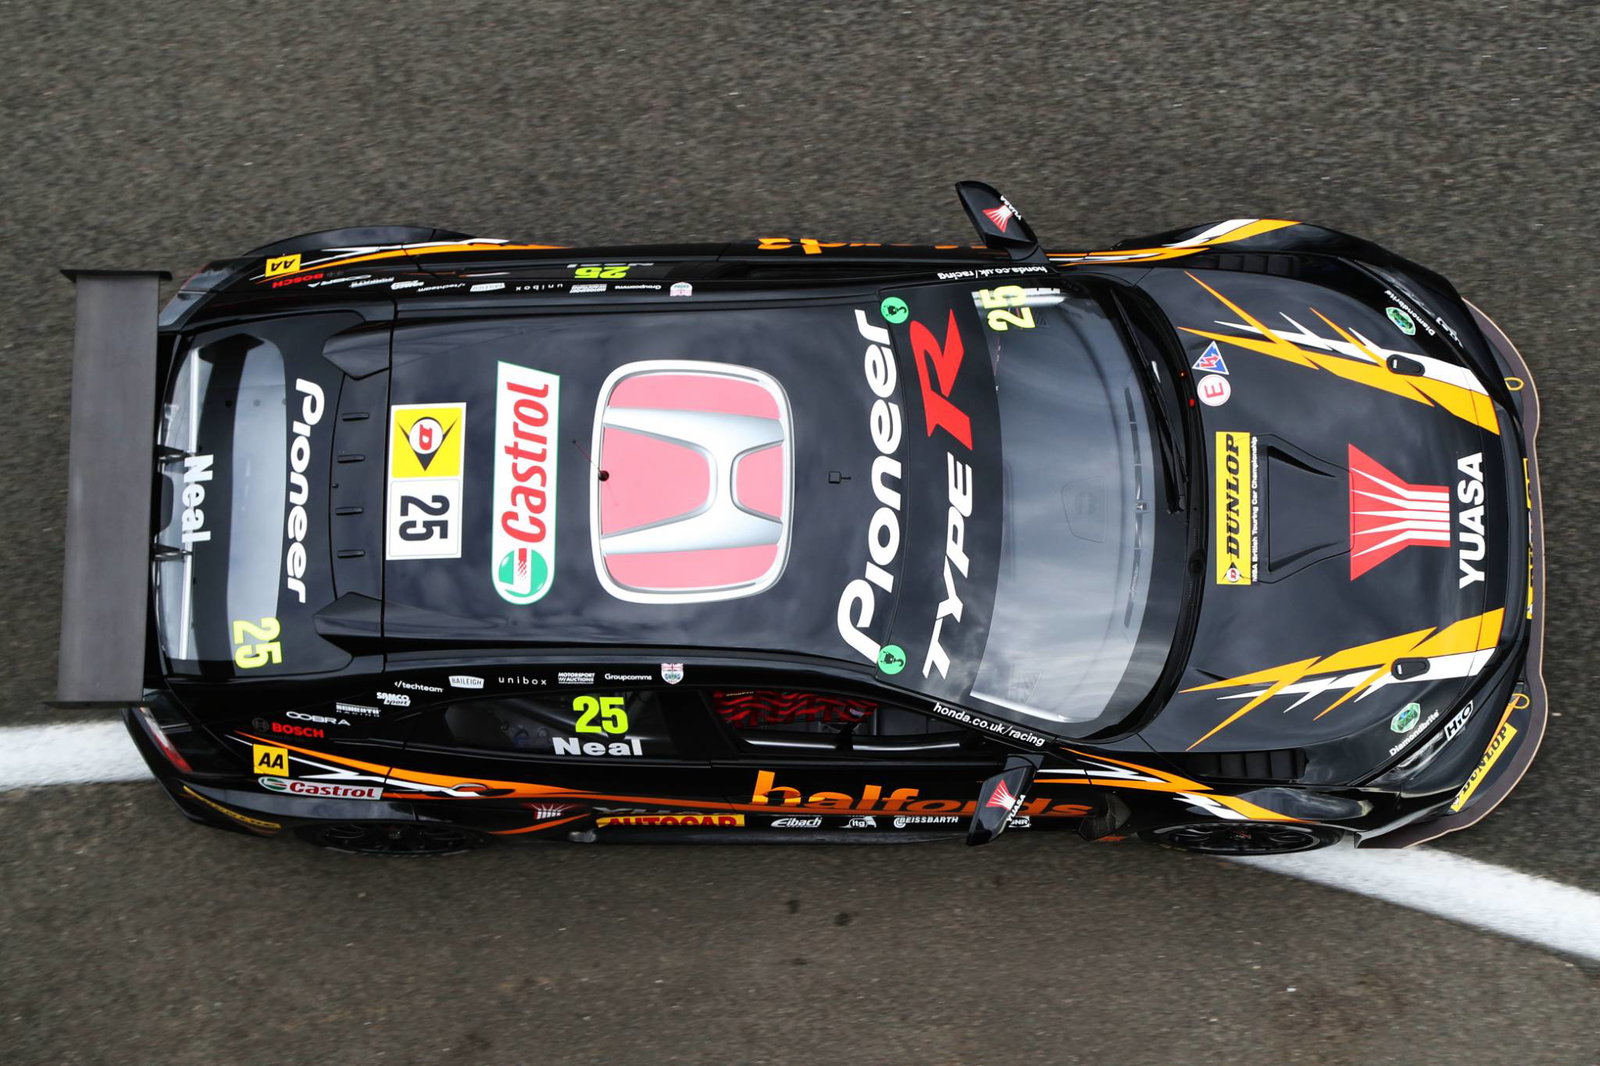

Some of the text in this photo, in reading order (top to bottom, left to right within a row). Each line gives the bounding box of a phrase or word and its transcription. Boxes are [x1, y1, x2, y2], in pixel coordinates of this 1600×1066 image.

[271, 258, 295, 272] AA
[574, 266, 630, 279] 25
[979, 285, 1036, 331] 25
[1204, 382, 1225, 399] E
[500, 381, 550, 543] Castrol
[181, 454, 214, 543] Neal
[286, 378, 325, 604] Pioneer
[836, 309, 902, 664] Pioneer
[909, 308, 973, 680] TYPE R
[1226, 433, 1240, 559] DUNLOP
[399, 494, 451, 542] 25
[1251, 506, 1259, 535] Touring
[1457, 452, 1486, 589] YUASA
[232, 617, 282, 669] 25
[499, 676, 547, 686] unibox
[605, 673, 653, 681] Groupcomms
[271, 722, 325, 738] BOSCH
[286, 711, 351, 726] COBRA
[572, 695, 629, 734] 25
[933, 702, 1045, 747] honda.co.uk/racing
[552, 737, 643, 757] Neal
[1389, 709, 1439, 757] Diamondbrite
[258, 752, 284, 769] AA
[290, 782, 376, 799] Castrol
[771, 816, 822, 828] Eibach
[1007, 794, 1026, 822] YUASA
